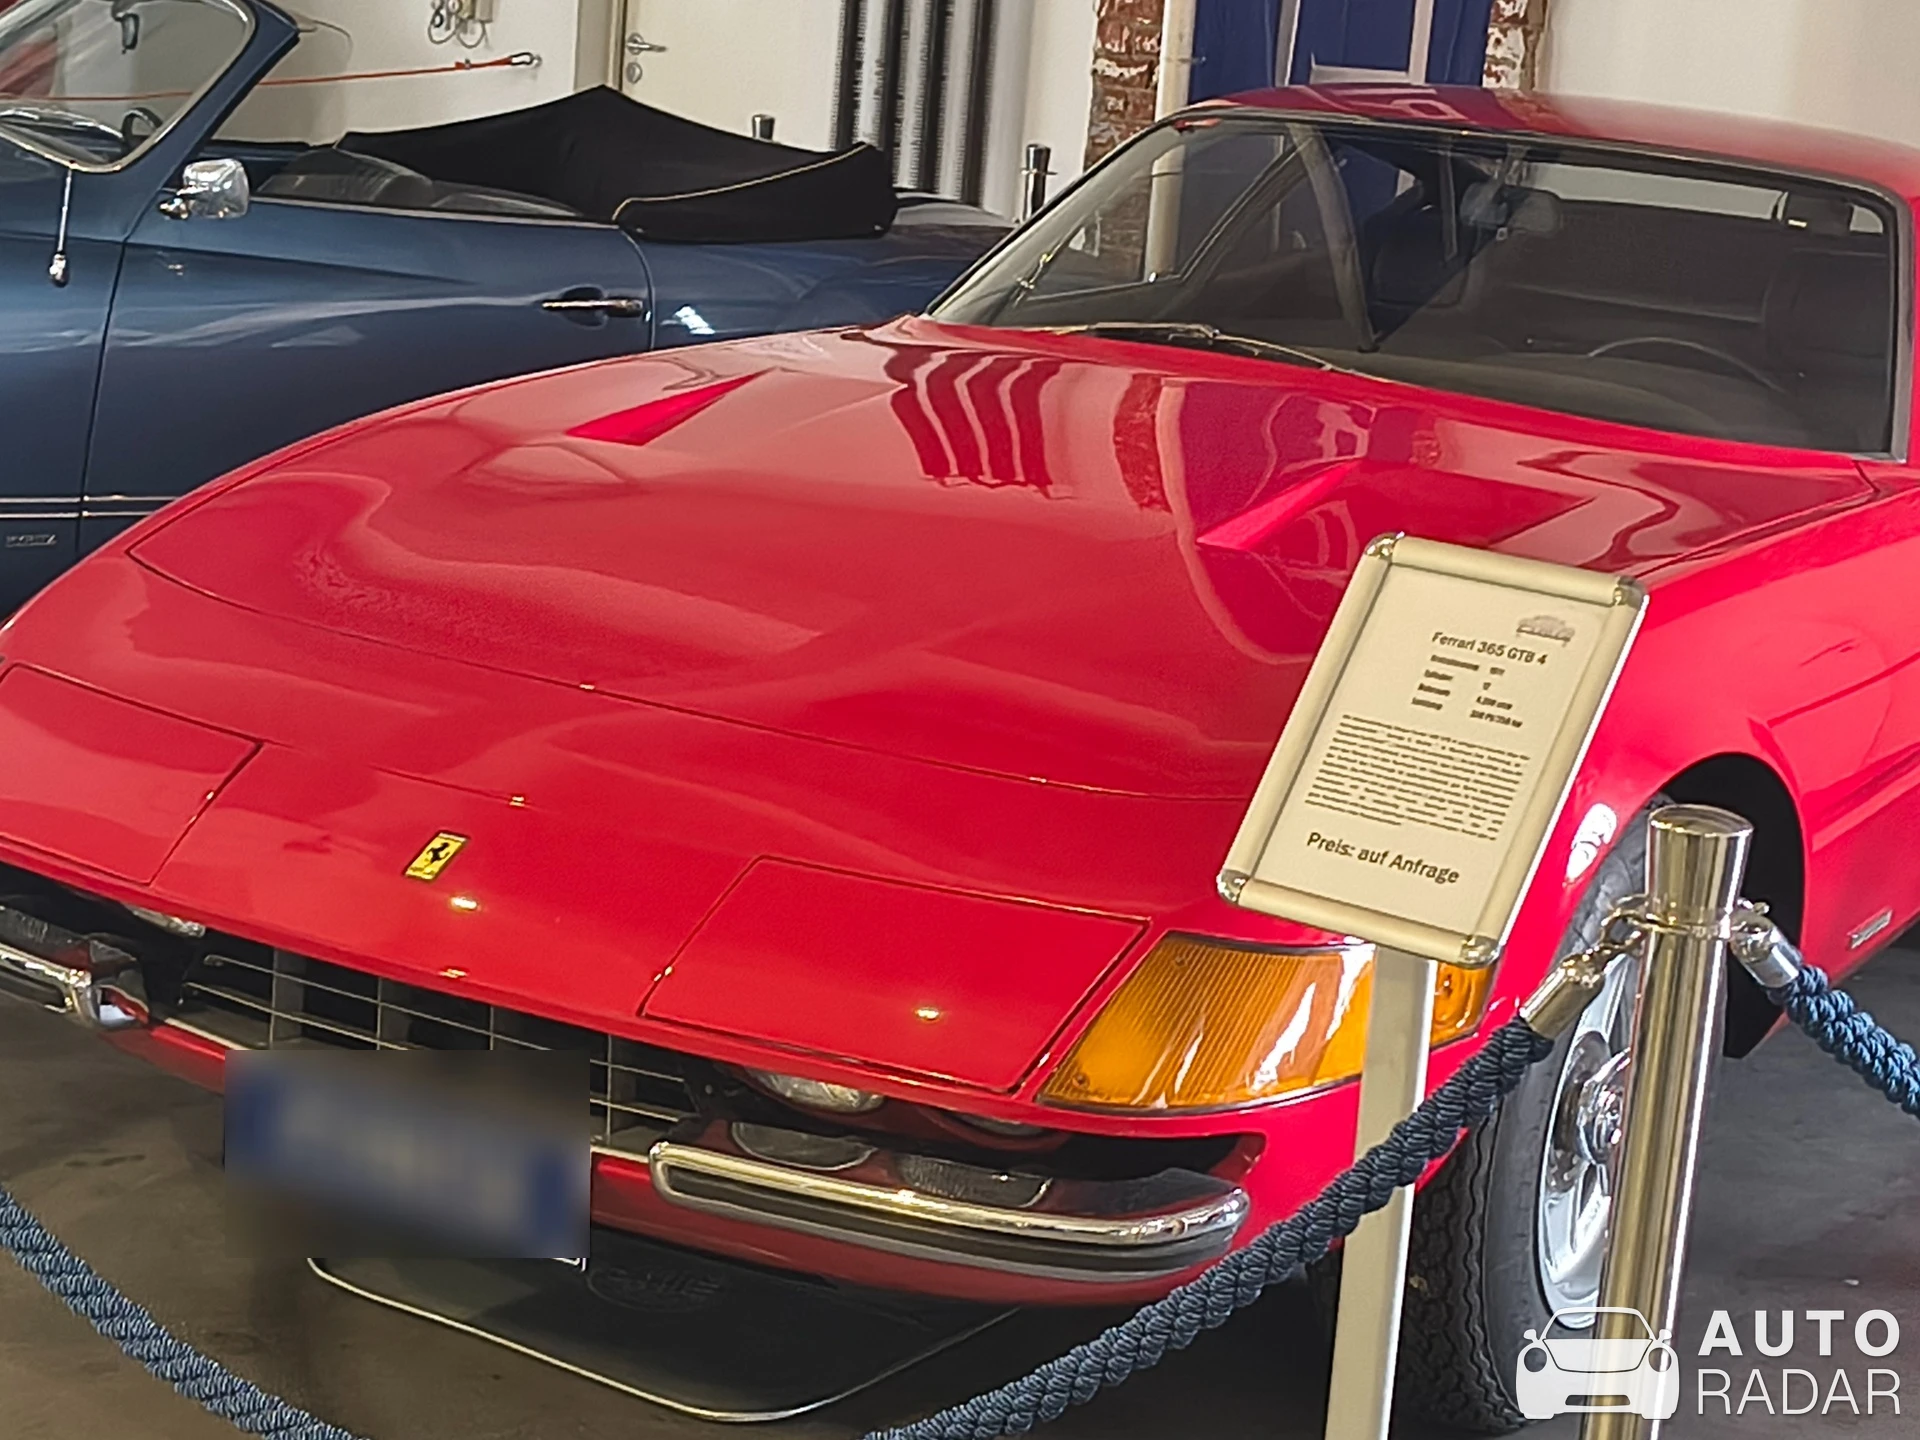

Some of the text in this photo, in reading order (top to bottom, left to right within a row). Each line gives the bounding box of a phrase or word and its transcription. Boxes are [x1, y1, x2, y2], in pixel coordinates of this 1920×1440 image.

[1432, 631, 1548, 665] Ferrari 365 GTB 4
[1307, 832, 1460, 884] Preis: auf Anfrage
